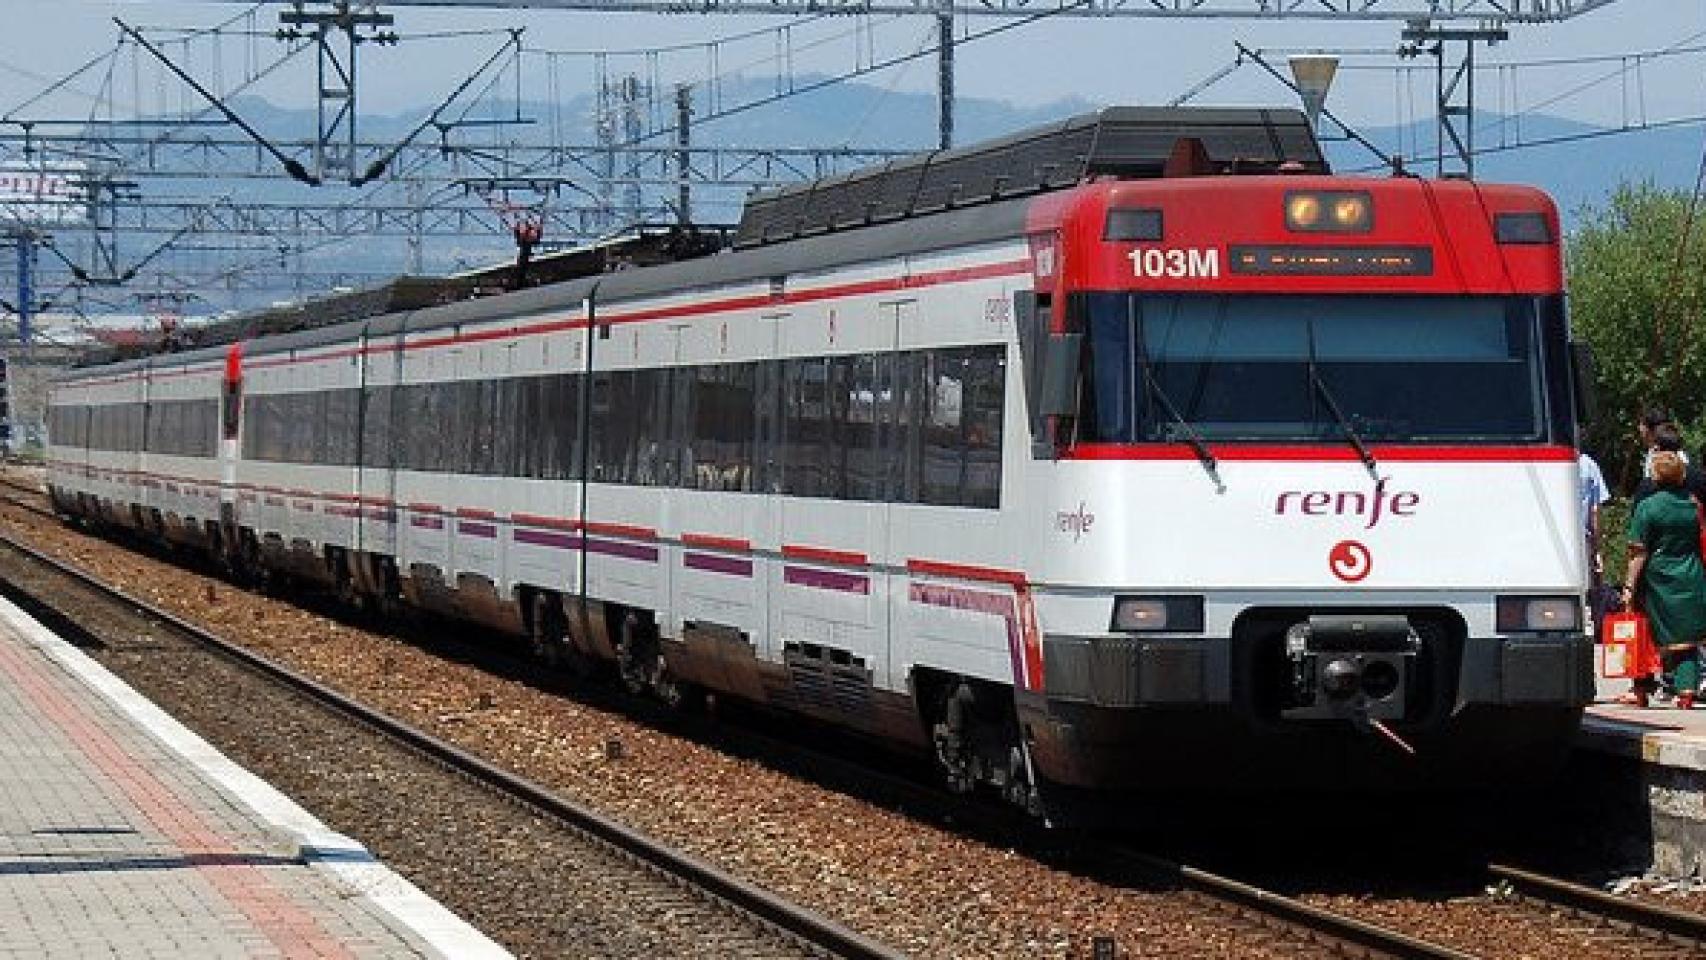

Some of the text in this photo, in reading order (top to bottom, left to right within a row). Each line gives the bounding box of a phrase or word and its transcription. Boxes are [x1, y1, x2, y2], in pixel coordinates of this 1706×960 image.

[1128, 249, 1219, 277] 103M
[1056, 500, 1095, 543] renfe
[1275, 476, 1420, 529] renfe
